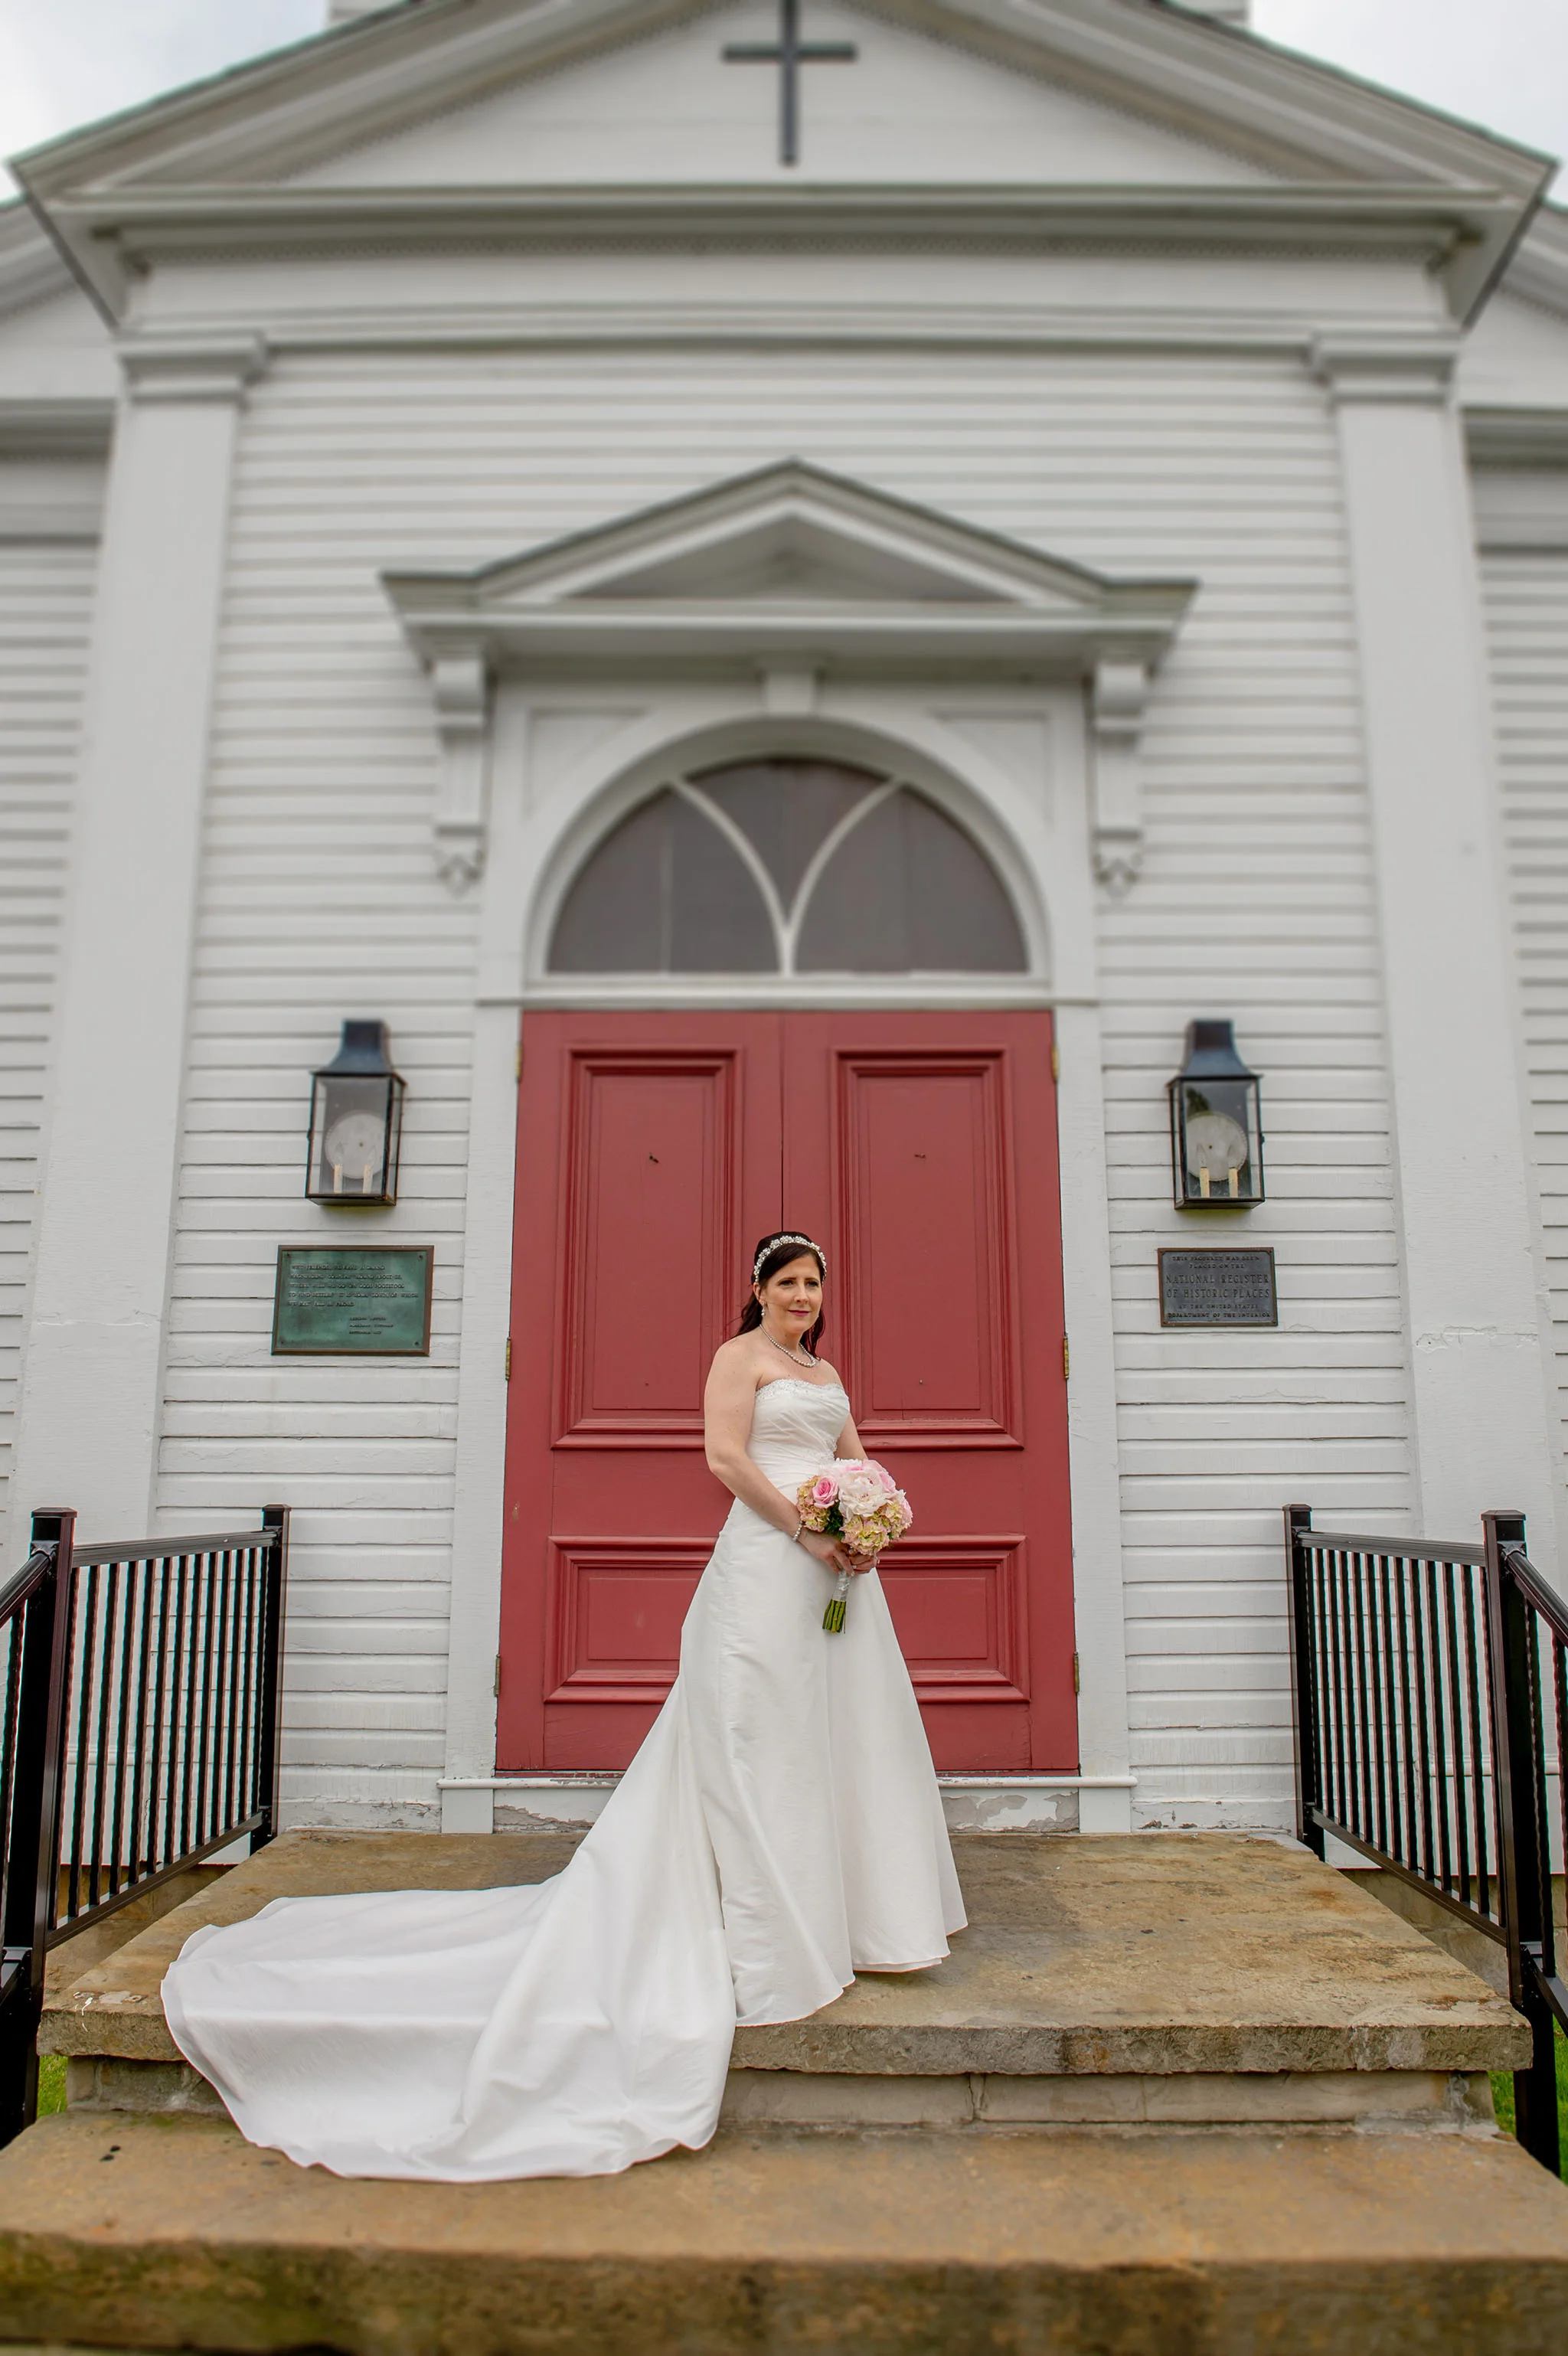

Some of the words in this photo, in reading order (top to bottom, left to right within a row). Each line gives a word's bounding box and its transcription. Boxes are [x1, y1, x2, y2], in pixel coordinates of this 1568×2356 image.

[1166, 1274, 1214, 1283] NATIONAL
[1221, 1274, 1269, 1283] REGISTER
[1166, 1289, 1178, 1298] OF
[1184, 1289, 1229, 1298] HISTORIC
[1233, 1289, 1269, 1298] PLACES
